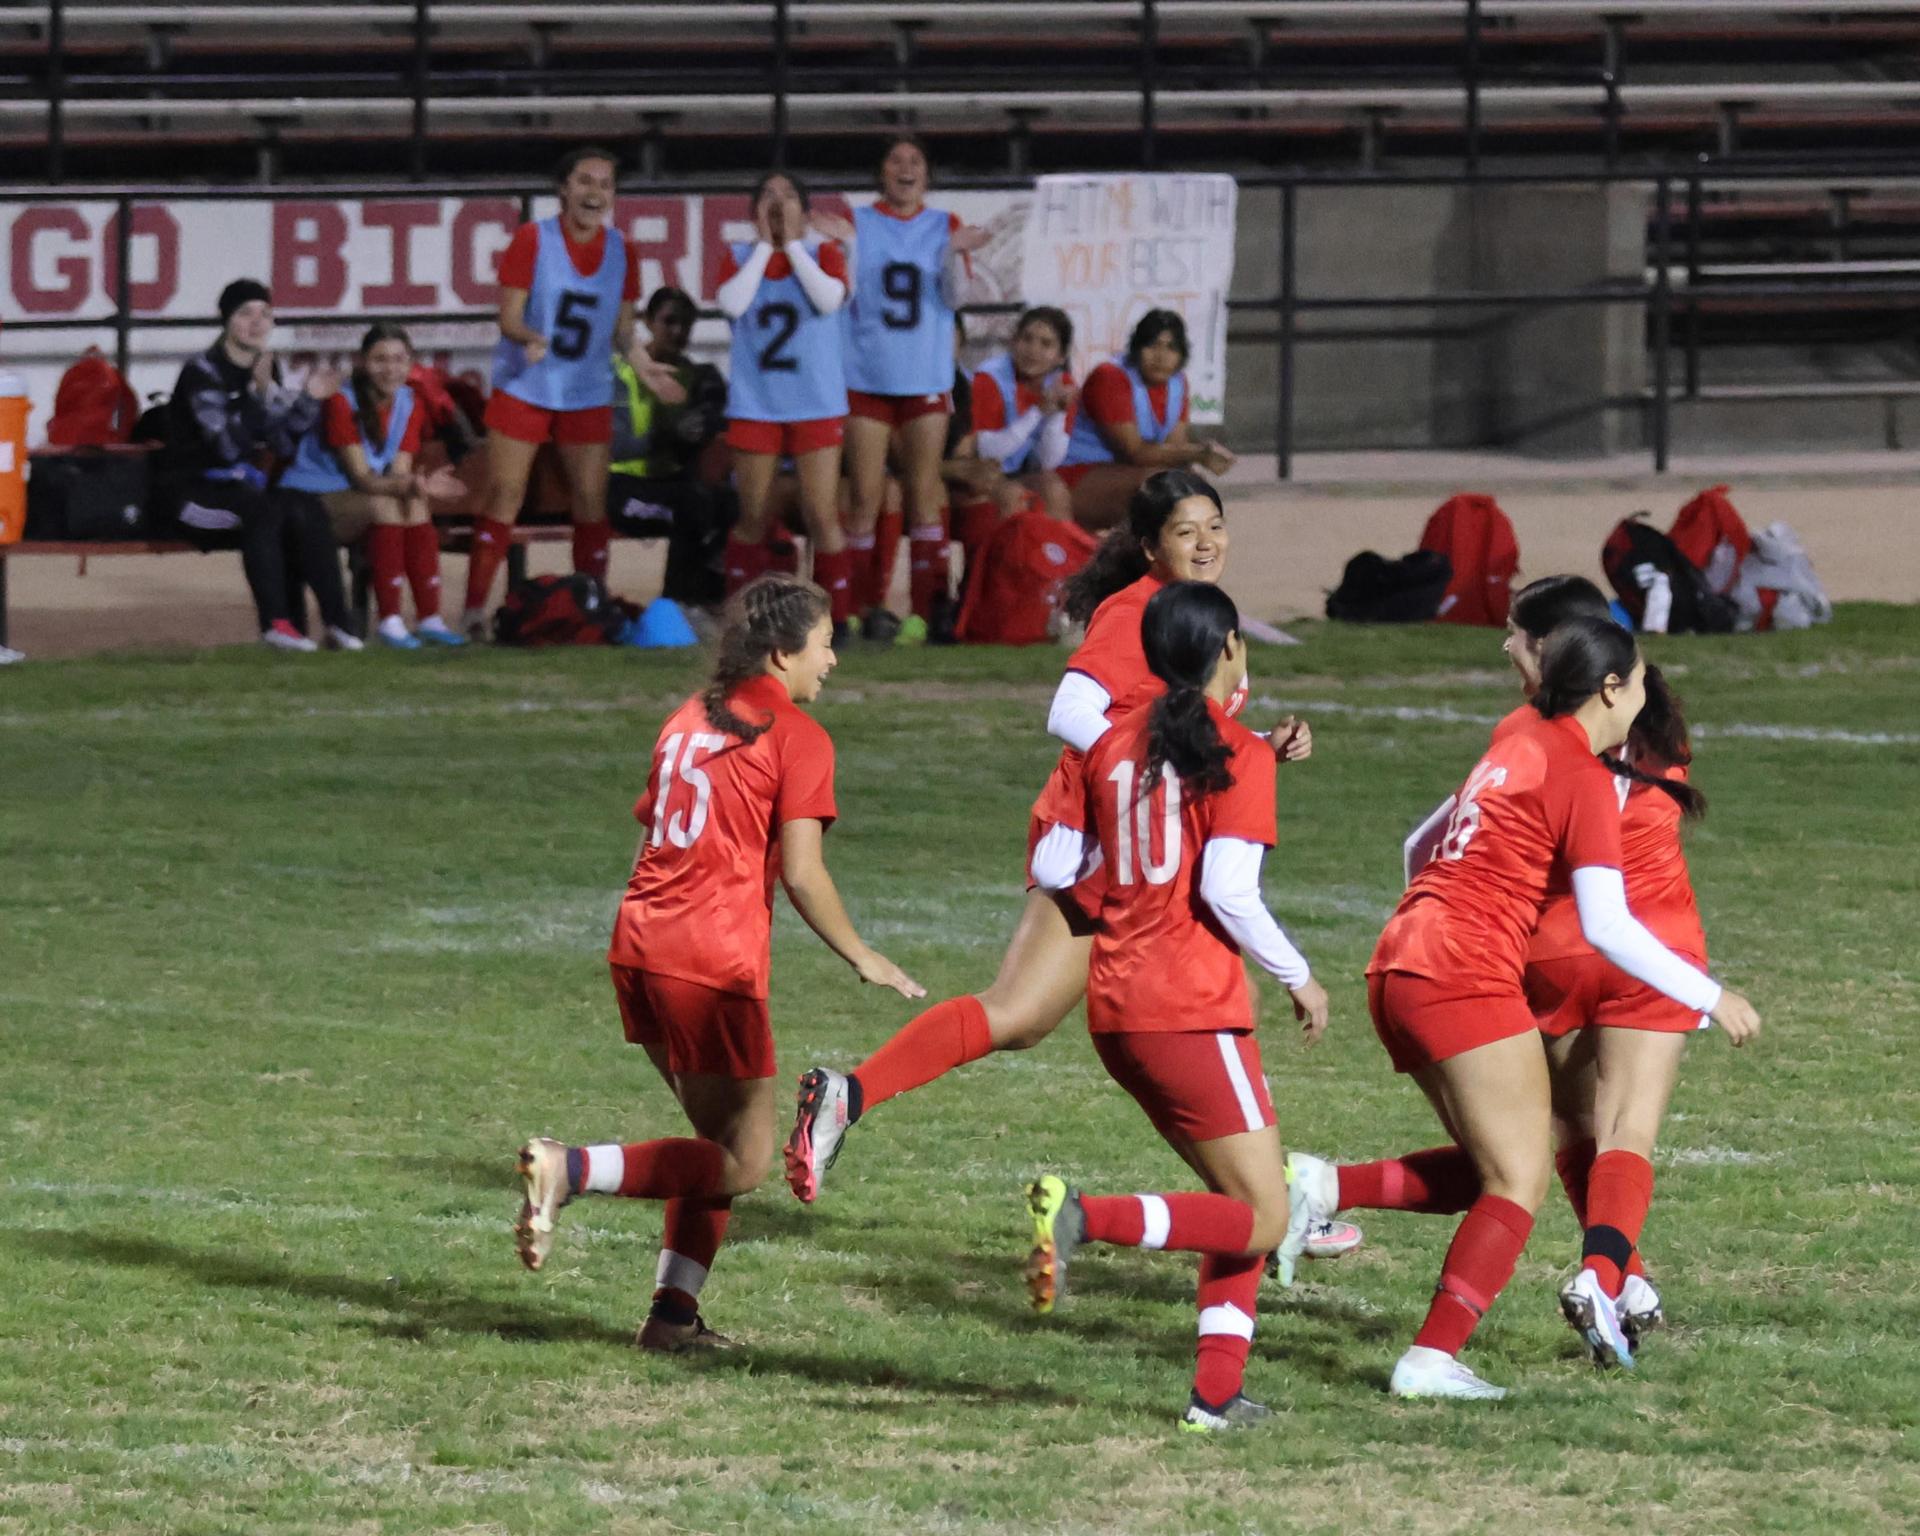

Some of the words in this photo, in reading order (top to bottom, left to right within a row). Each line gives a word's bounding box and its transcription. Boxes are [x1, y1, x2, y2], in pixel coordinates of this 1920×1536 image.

[10, 205, 180, 313] GO
[1055, 241, 1121, 289] YOUR
[1126, 237, 1207, 289] BEST
[551, 289, 598, 359] 5
[882, 261, 922, 330] 9
[758, 304, 800, 371] 2
[652, 732, 727, 849] 15
[1107, 760, 1182, 885] 10
